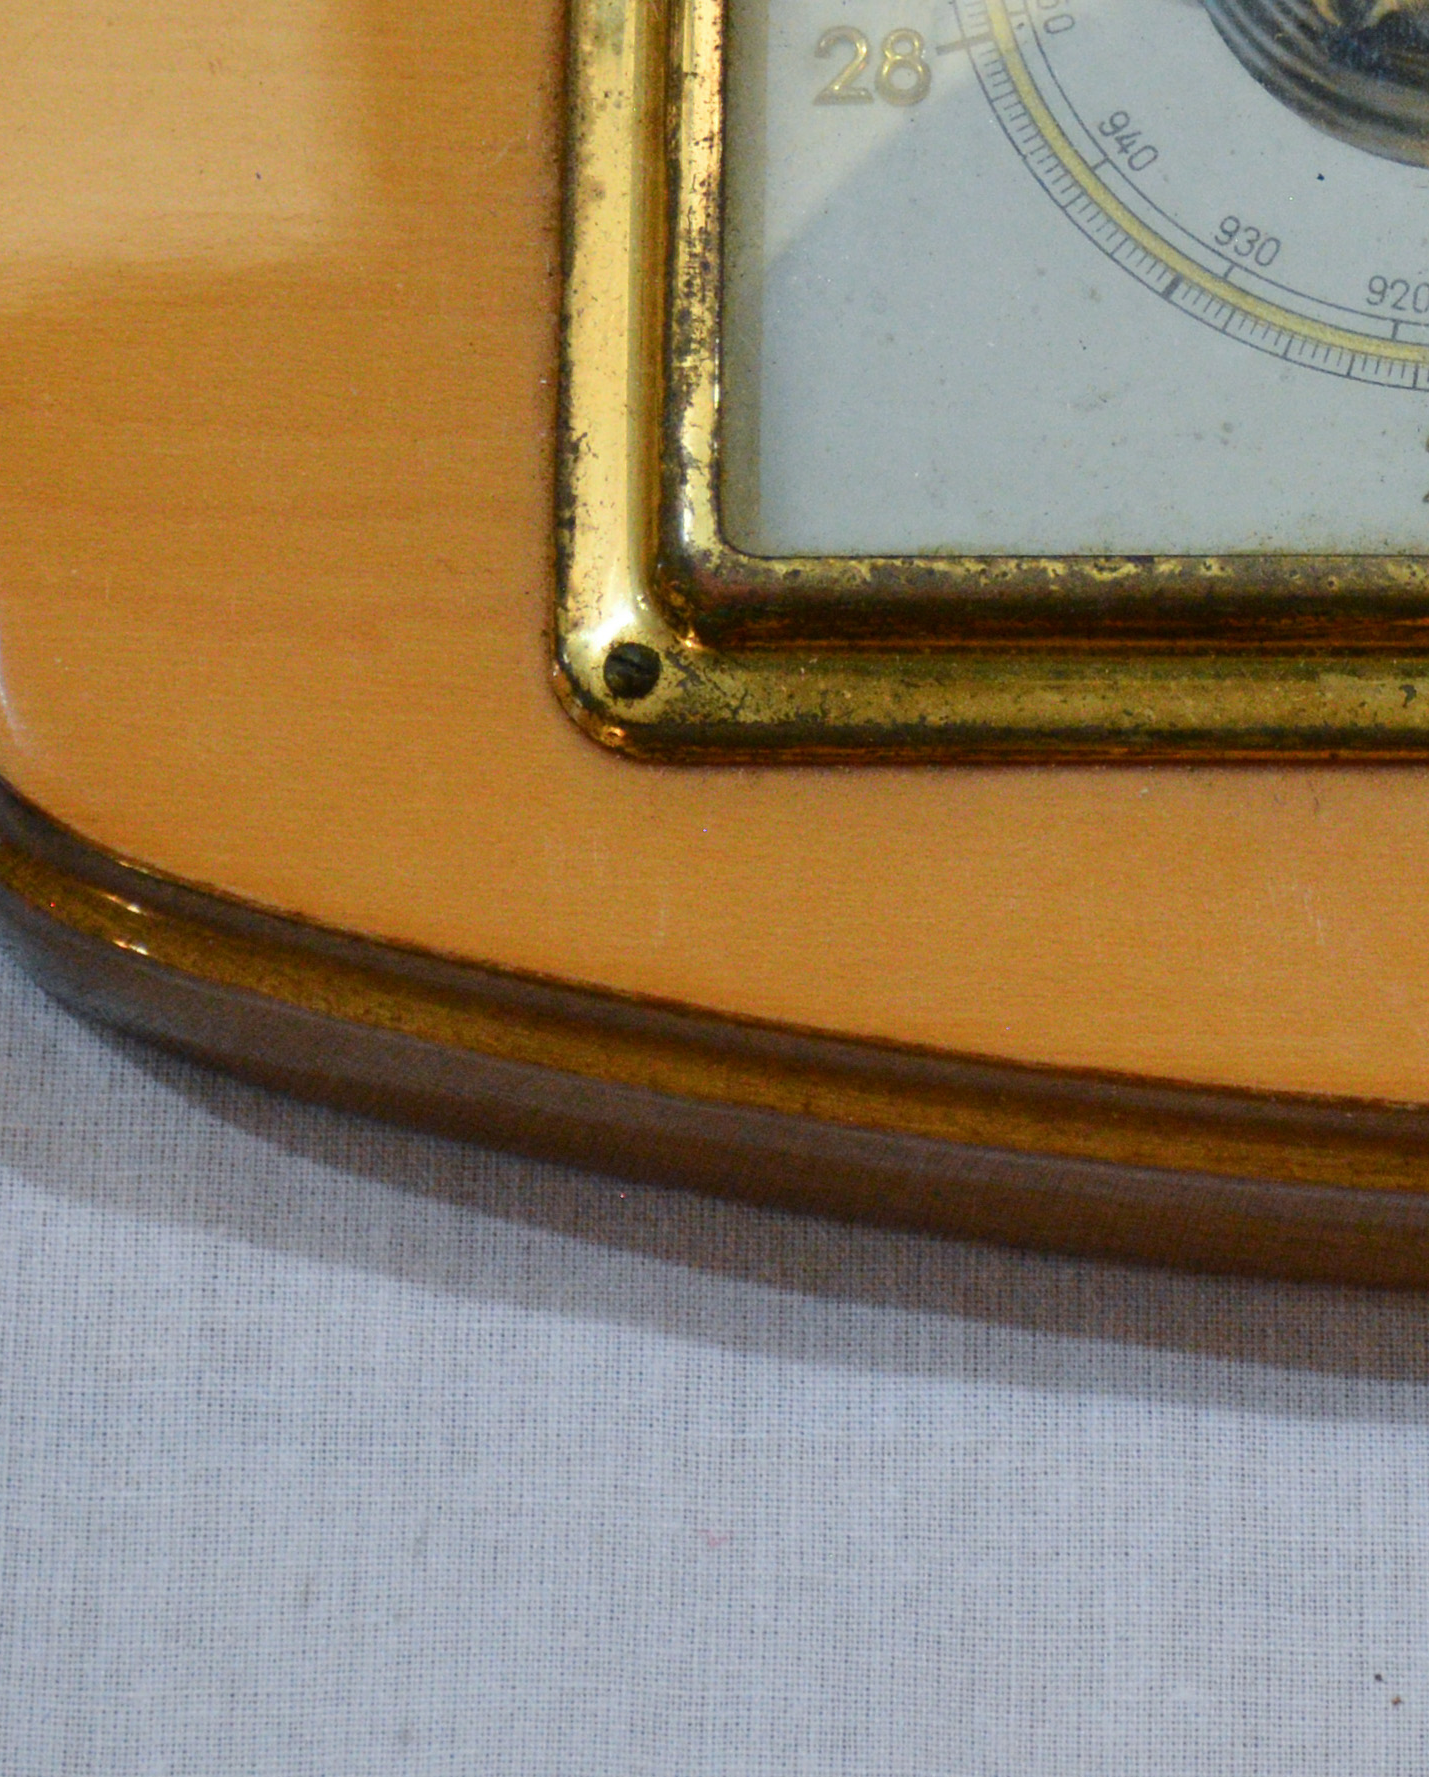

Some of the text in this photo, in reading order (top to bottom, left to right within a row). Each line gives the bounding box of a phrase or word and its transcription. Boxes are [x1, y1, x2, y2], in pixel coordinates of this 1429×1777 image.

[812, 25, 933, 107] 28
[1097, 109, 1161, 173] 940
[1213, 214, 1283, 268] 930
